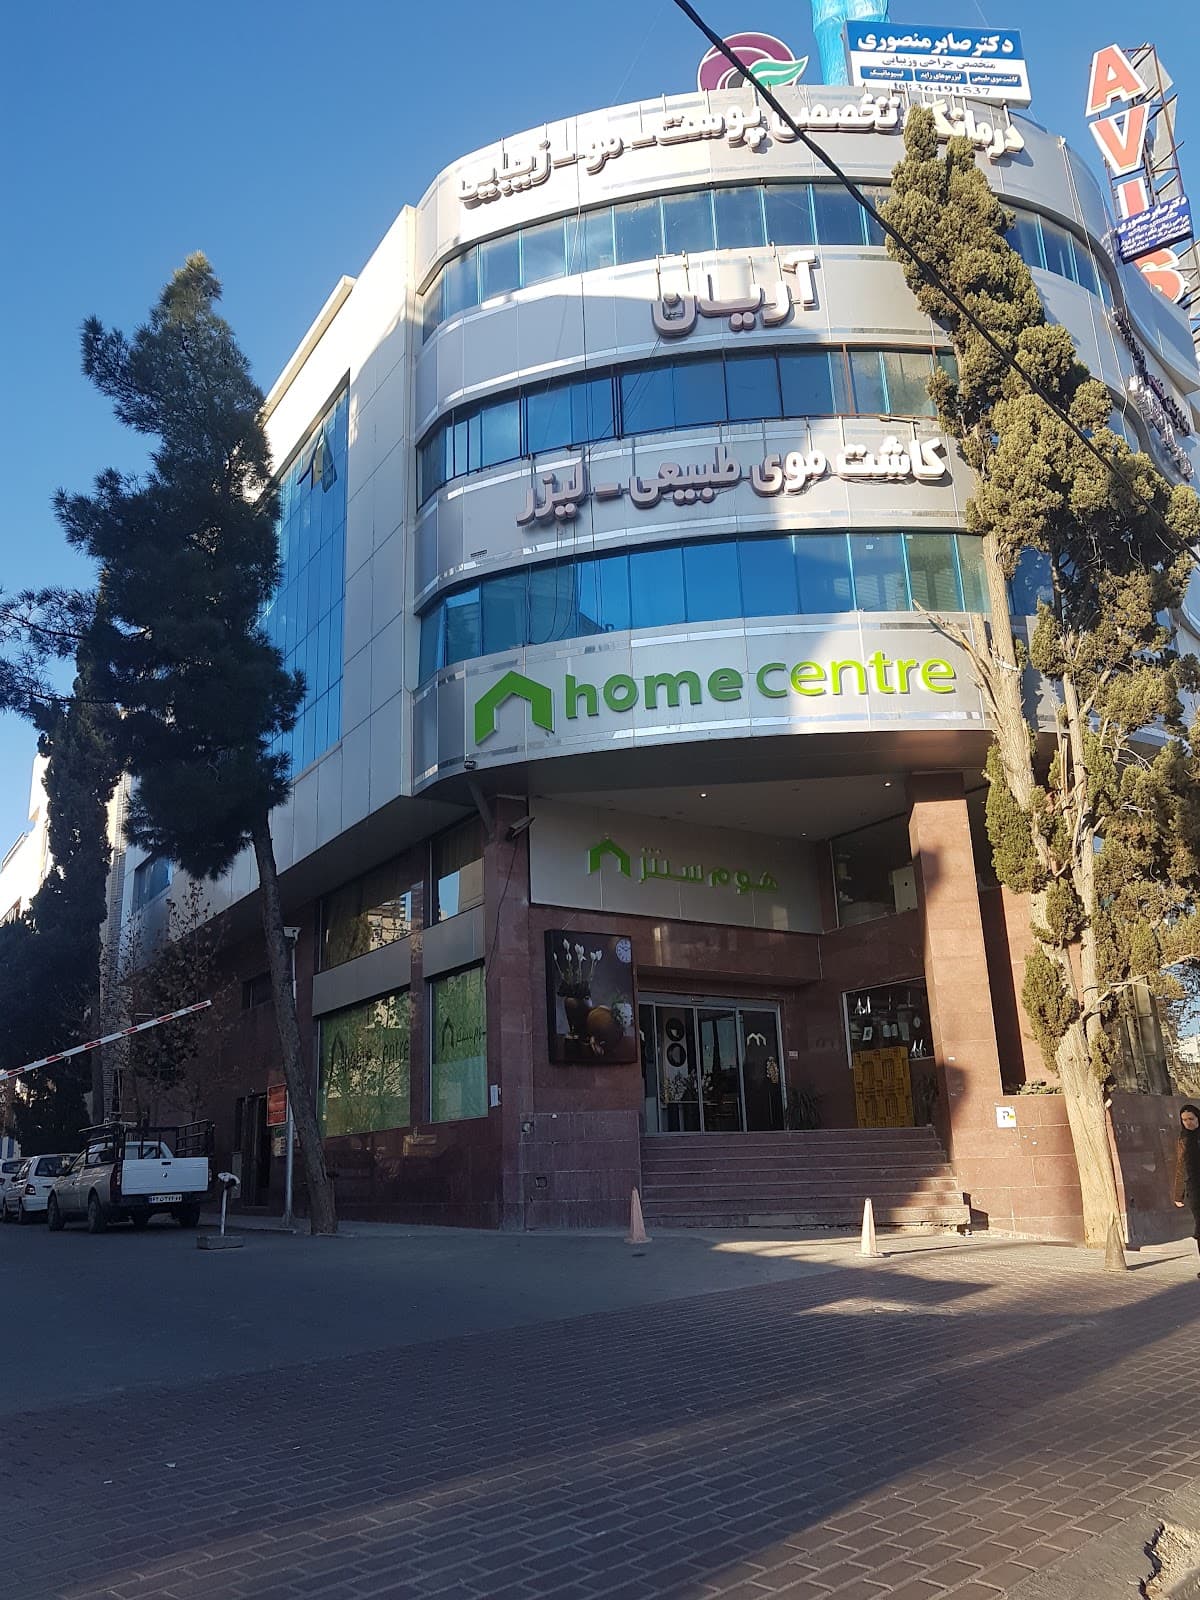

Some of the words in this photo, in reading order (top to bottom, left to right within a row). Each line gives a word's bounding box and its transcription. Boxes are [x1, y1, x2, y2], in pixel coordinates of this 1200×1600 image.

[857, 32, 932, 52] منصوری
[930, 32, 973, 55] صابر
[972, 35, 1014, 57] دکتر
[915, 83, 990, 95] 36491537
[658, 105, 768, 148] پوست
[770, 92, 900, 141] تخصصی
[458, 138, 551, 201] زیبایی
[651, 249, 817, 337] آریان
[629, 446, 742, 505] طبیعی
[751, 449, 828, 496] موی
[836, 435, 946, 481] کاشت
[516, 458, 585, 527] لیزر
[565, 667, 743, 720] home
[755, 649, 956, 699] centre
[638, 847, 704, 885] سنتر
[708, 865, 778, 895] هوم
